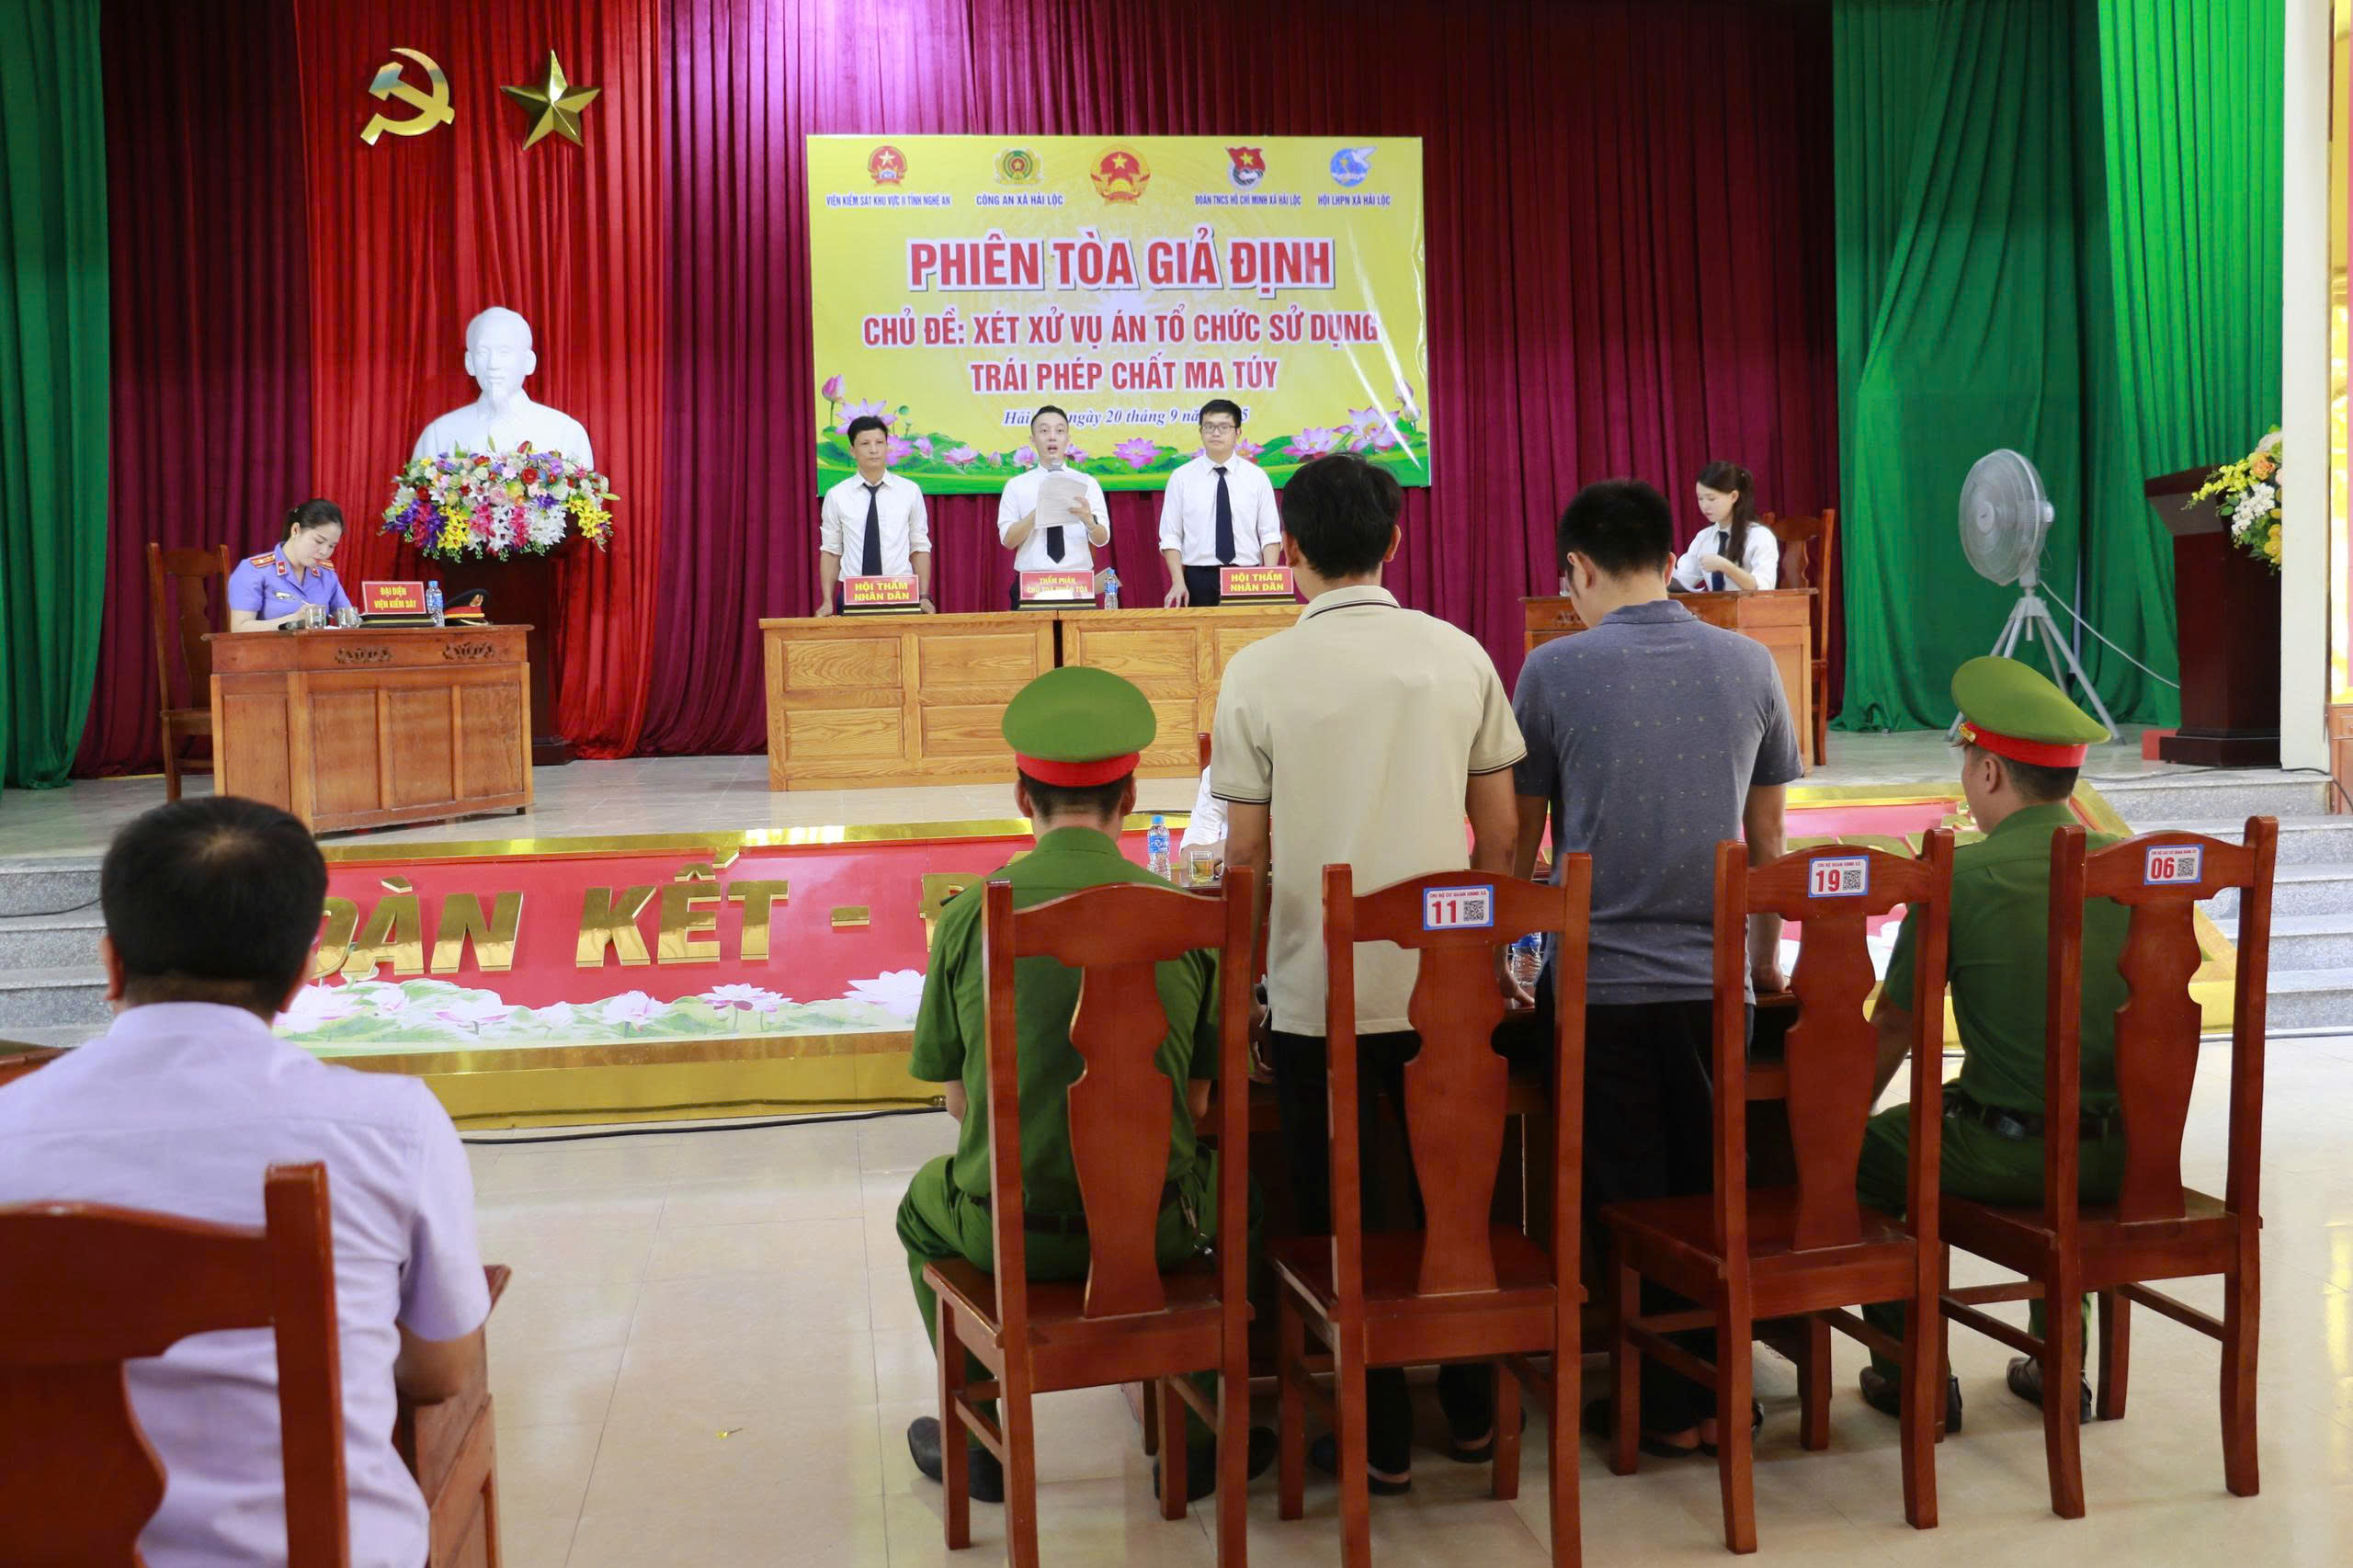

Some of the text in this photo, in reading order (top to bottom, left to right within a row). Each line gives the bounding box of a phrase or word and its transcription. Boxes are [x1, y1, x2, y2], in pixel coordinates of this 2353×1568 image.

[941, 196, 950, 206] AN
[976, 192, 1063, 207] CÔNG AN XÃ HẢI LỘC
[1213, 195, 1229, 205] TNCS
[1251, 195, 1267, 205] MINH
[1317, 194, 1329, 207] HỘI
[1331, 196, 1350, 206] LHPN
[1352, 194, 1361, 206] XÃ
[1377, 194, 1391, 207] LỘC
[911, 227, 1330, 293] PHIÊN TÒA GIẢ ĐỊNH
[864, 303, 1379, 349] CHỦ ĐỀ: XÉT XỬ VỤ ÁN TỔ CHỨC SỬ DỤNG
[971, 352, 1278, 392] TRÁI PHÉP CHẤT MA TÚY
[1068, 410, 1101, 426] ngày
[1106, 409, 1121, 423] 20
[1126, 409, 1165, 426] tháng
[1170, 408, 1177, 422] 9
[1182, 410, 1199, 422] nă
[1230, 581, 1284, 591] NHÂN DÂN
[1231, 573, 1249, 583] HỘI
[855, 581, 874, 592] HỘI
[854, 591, 910, 601] NHÂN DÂN
[2151, 857, 2175, 879] 06
[1815, 869, 1840, 892] 19
[575, 851, 789, 968] KẾT
[1431, 900, 1457, 924] 11
